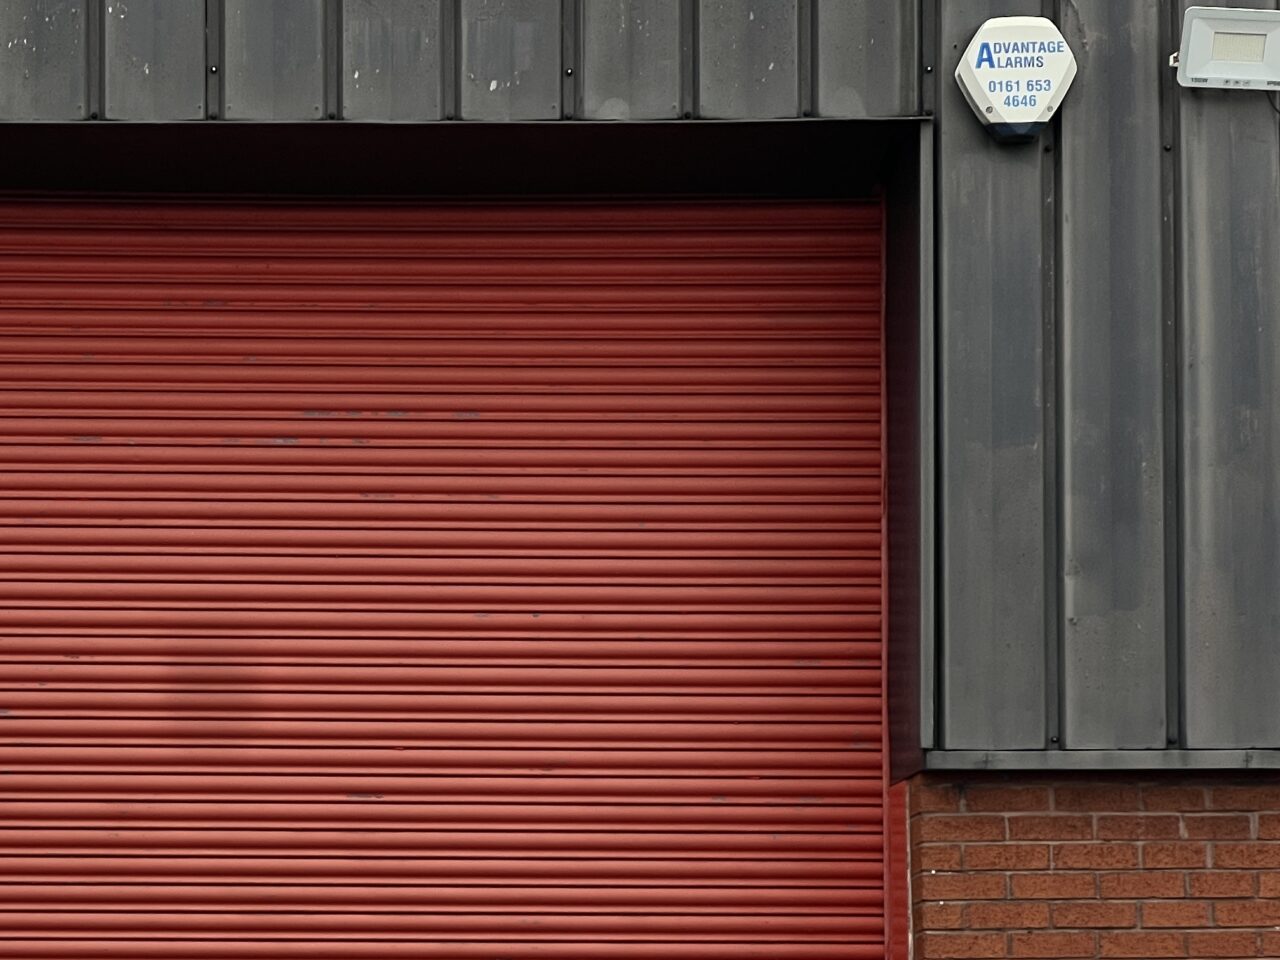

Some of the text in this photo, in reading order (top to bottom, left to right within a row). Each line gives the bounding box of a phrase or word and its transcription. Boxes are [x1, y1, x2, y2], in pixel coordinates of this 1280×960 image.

[988, 79, 1052, 93] 0161 653
[1003, 95, 1037, 107] 4646
